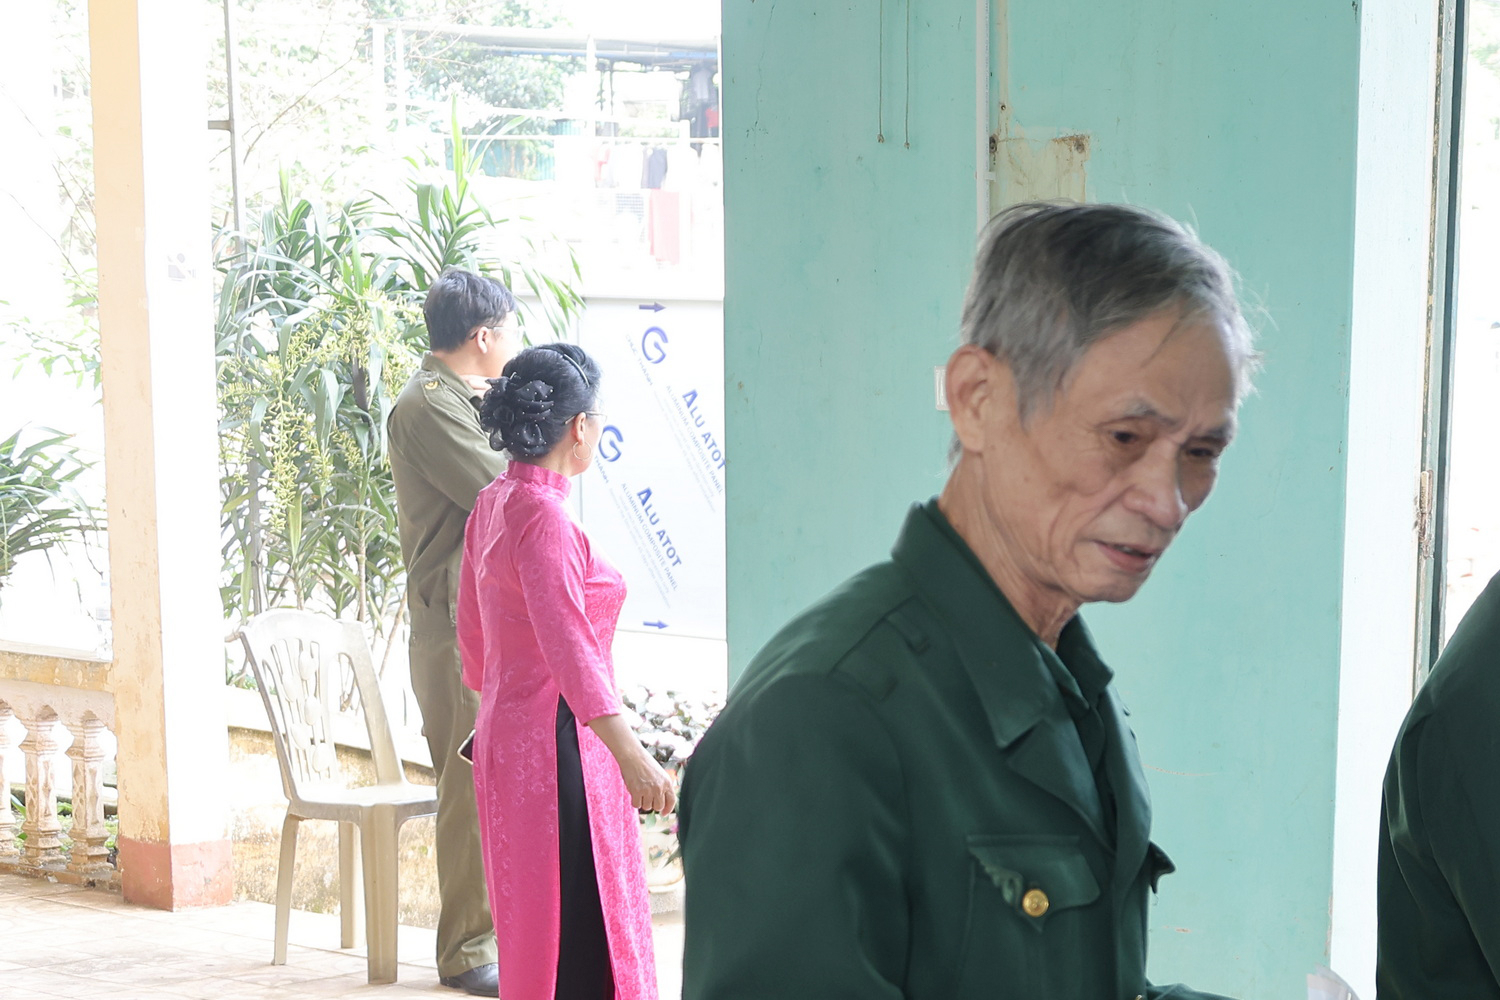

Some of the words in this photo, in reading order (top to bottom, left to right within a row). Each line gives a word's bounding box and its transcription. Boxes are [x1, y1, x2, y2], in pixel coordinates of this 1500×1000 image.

[666, 385, 689, 426] ALUMINUM
[687, 426, 712, 470] COMPOSITE
[709, 470, 723, 495] PANEL
[622, 483, 644, 524] ALUMINUM
[642, 524, 666, 567] COMPOSITE
[664, 567, 678, 591] PANEL
[636, 487, 660, 526] ALU
[656, 529, 682, 567] ATOT
